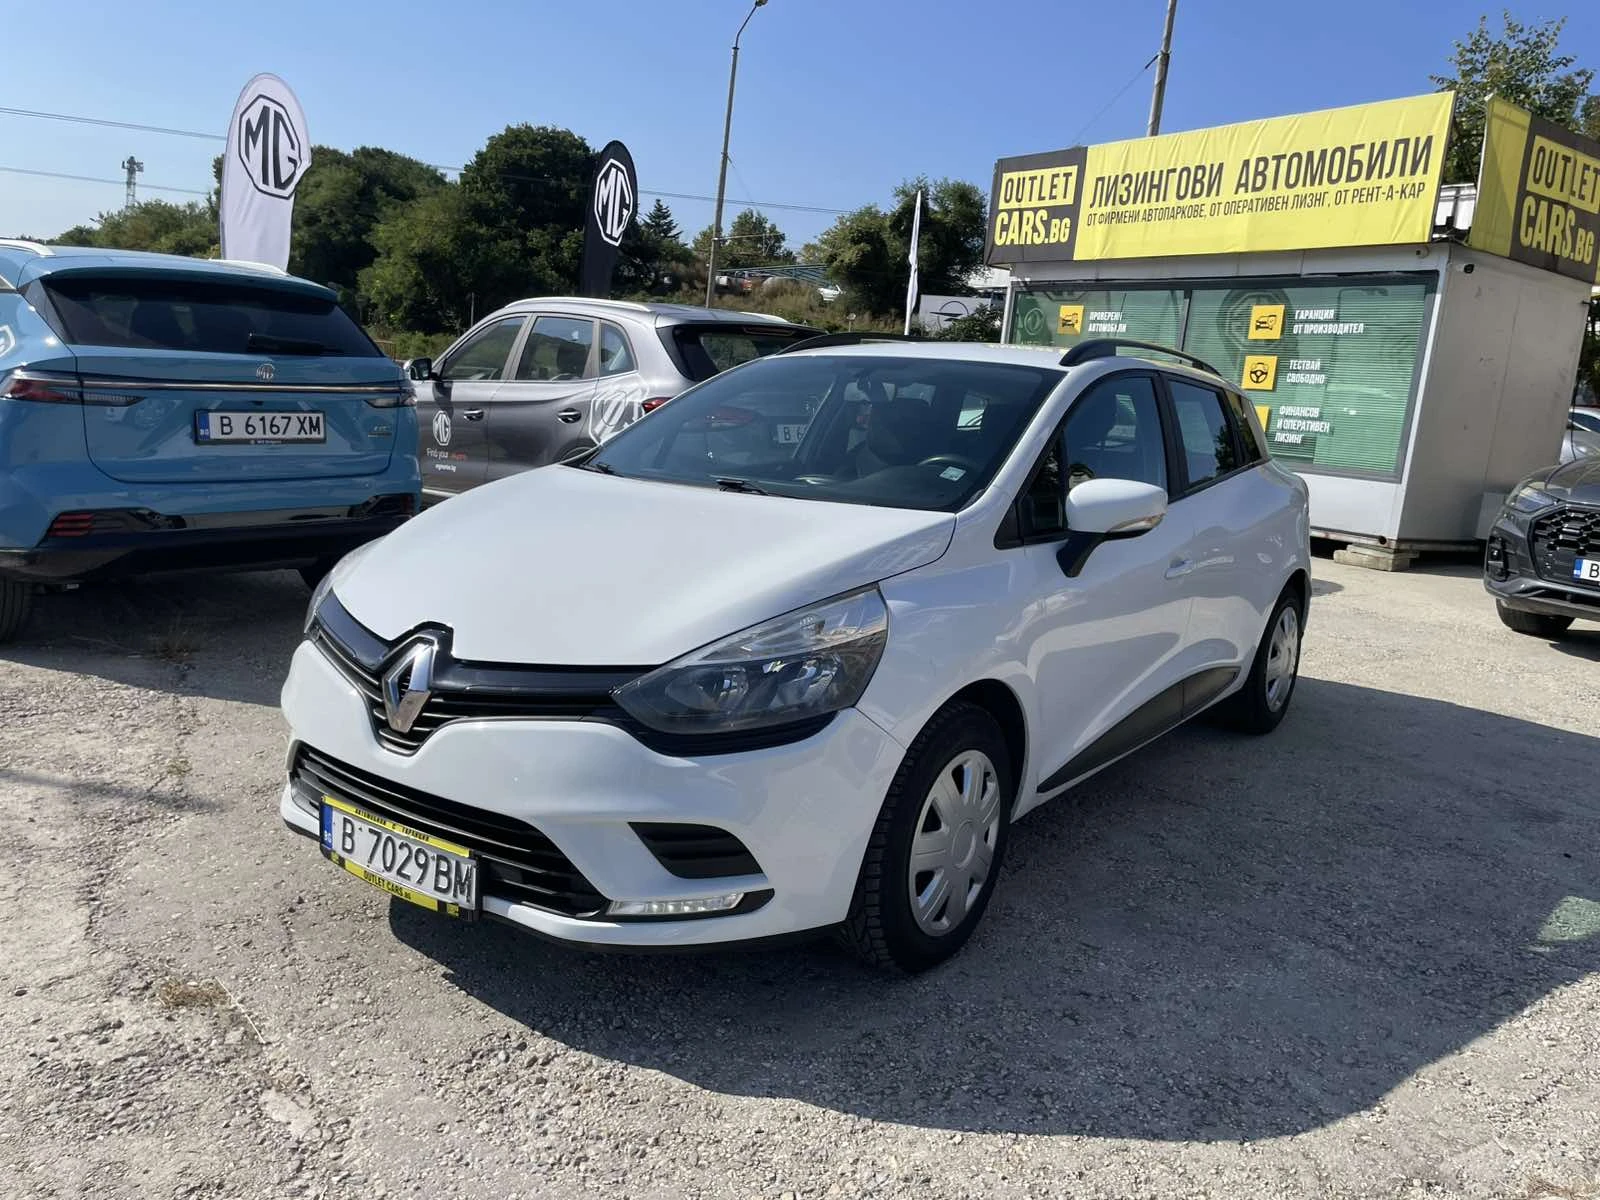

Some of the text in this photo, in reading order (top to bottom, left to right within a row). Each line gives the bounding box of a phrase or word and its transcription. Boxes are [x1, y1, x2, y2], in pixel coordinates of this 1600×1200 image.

[244, 105, 297, 190] MG
[1003, 171, 1073, 204] OUTLET
[1090, 135, 1433, 208] ЛИЗИНГОВИ АВТОМОБИЛИ
[1532, 144, 1600, 205] OUTLET
[598, 167, 629, 239] MG
[1087, 212, 1097, 226] ОТ
[1098, 209, 1140, 225] ФИРМЕНИ
[1142, 203, 1207, 223] АВТОПАРКОВЕ,
[1209, 201, 1223, 217] ОТ
[1223, 195, 1289, 216] ОПЕРАТИВЕН
[1334, 187, 1350, 206] ОТ
[1351, 181, 1426, 204] РЕНТ-А-КАР
[994, 209, 1071, 246] CARS.BG
[1519, 195, 1594, 266] CARS.BG
[1293, 323, 1364, 335] ОТ ПРОИЗВОДИТЕЛ
[1294, 309, 1335, 320] ГАРАНЦИЯ
[1286, 373, 1325, 385] СВОБОДНО
[1289, 359, 1321, 371] ТЕСТВАЙ
[220, 416, 233, 435] B
[1280, 405, 1320, 417] ФИНАНСОВ
[1283, 419, 1330, 433] ОПЕРАТИВЕН
[1274, 432, 1304, 444] ЛИЗИНГ
[342, 817, 355, 853] B
